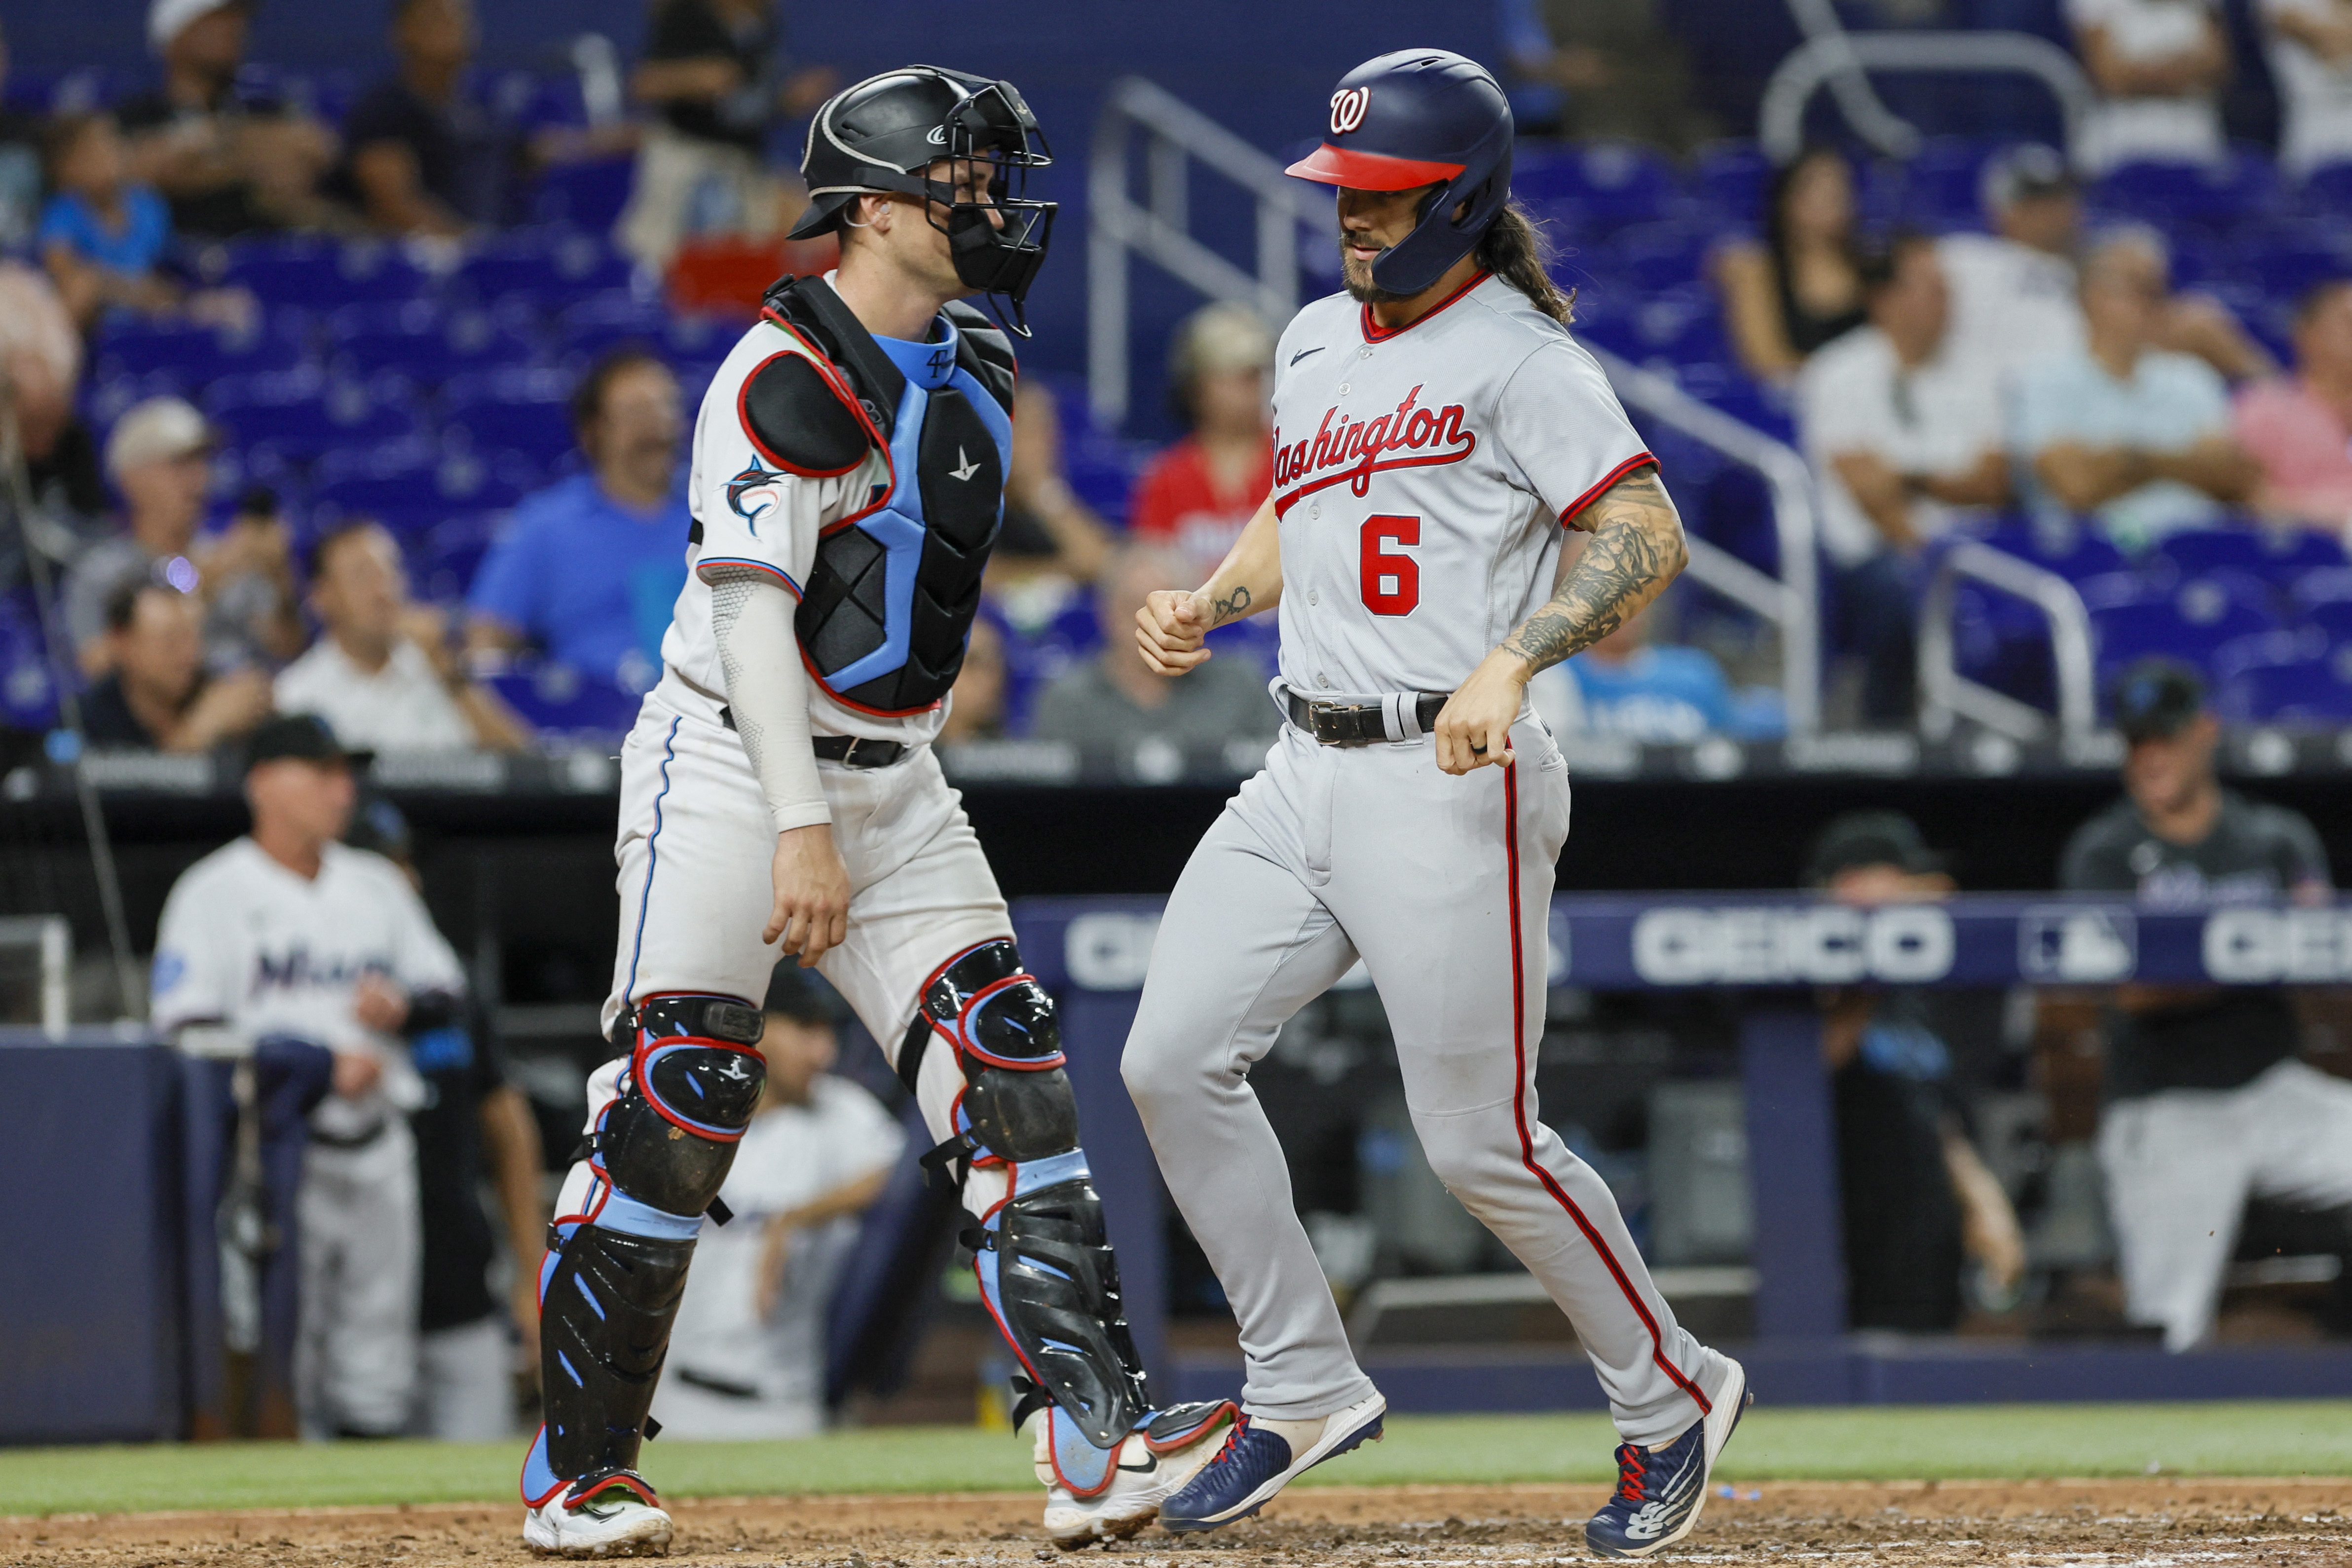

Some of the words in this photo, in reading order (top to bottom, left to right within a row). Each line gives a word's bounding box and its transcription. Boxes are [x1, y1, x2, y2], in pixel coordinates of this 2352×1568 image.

[1330, 86, 1371, 135] W
[1272, 381, 1476, 524] ashington
[1360, 512, 1422, 618] 6
[1632, 907, 1956, 985] GEICO
[2202, 908, 2352, 984] GE
